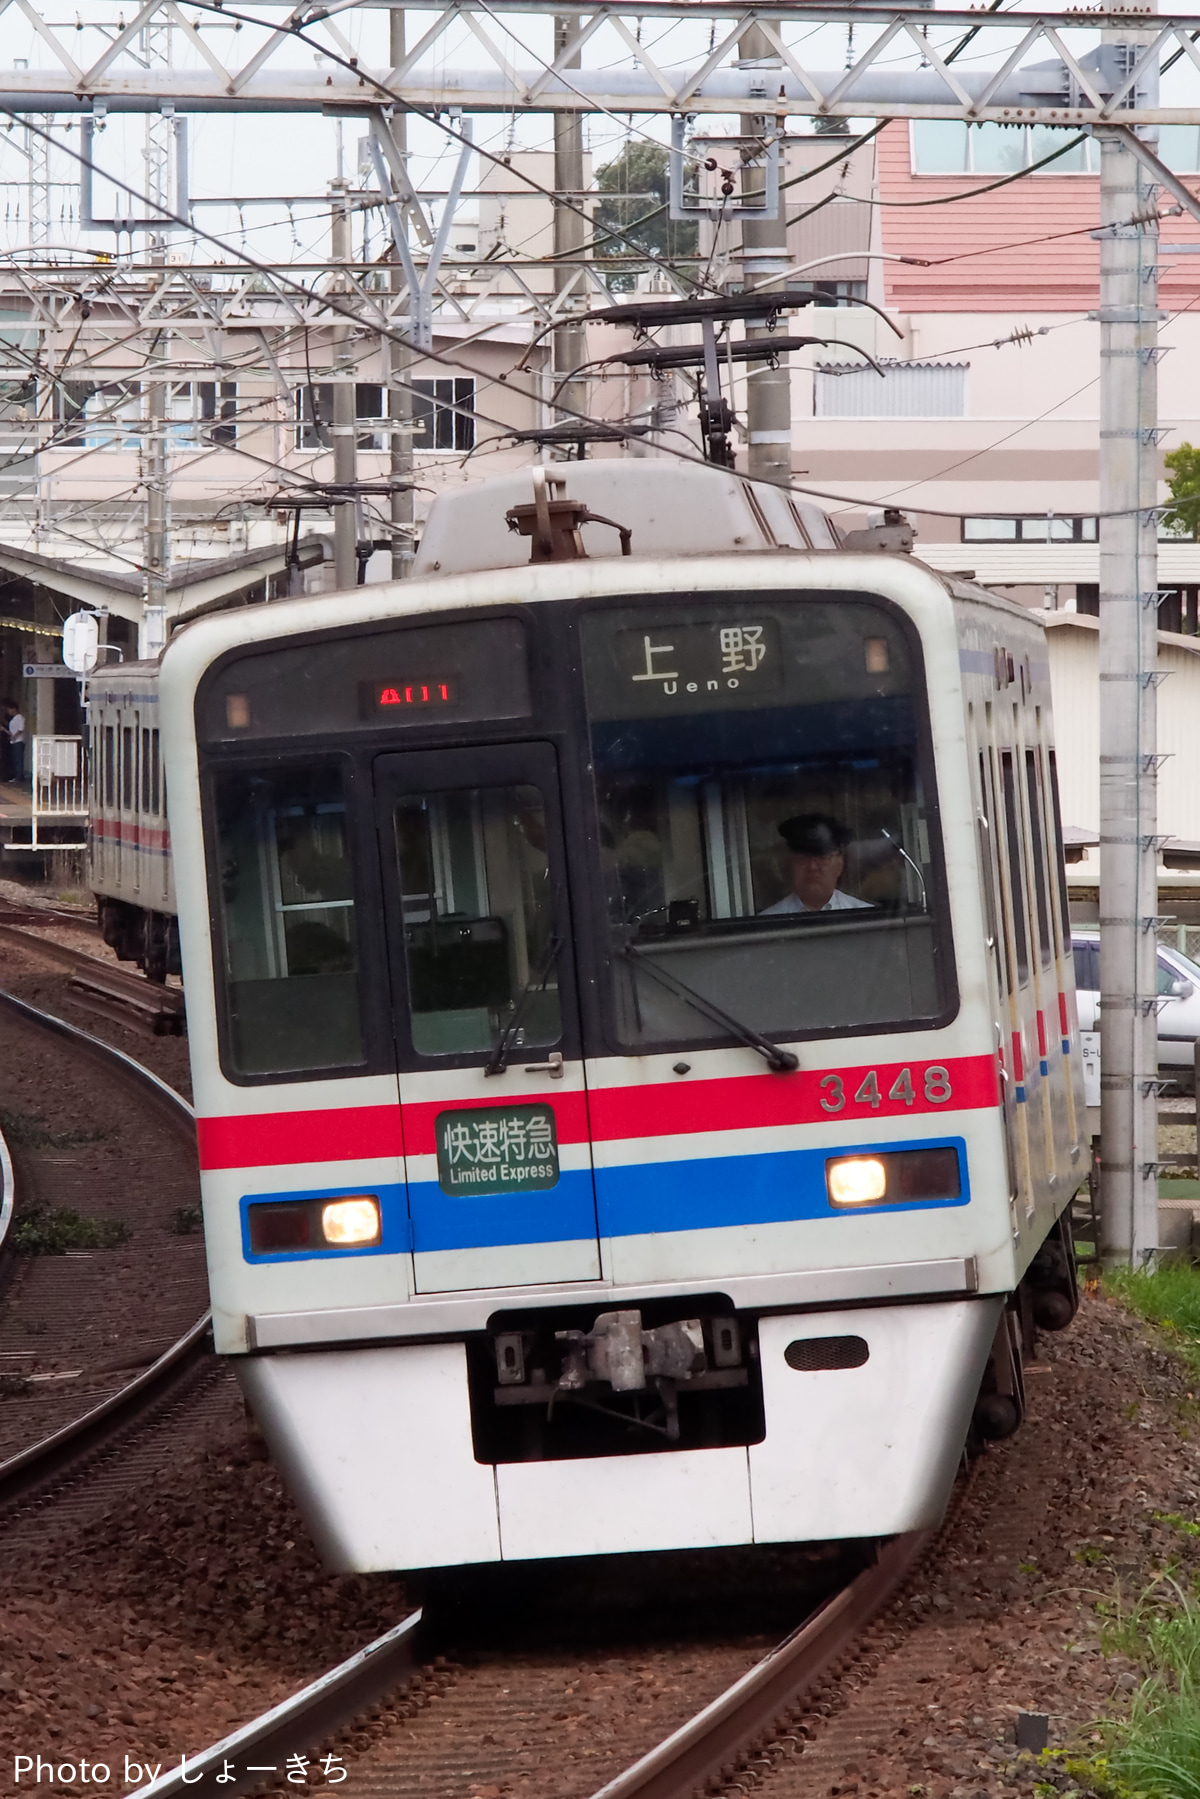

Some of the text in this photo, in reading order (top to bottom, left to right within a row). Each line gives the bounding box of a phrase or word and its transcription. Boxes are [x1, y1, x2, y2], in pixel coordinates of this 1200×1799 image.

[631, 625, 767, 682] 上野
[663, 678, 740, 695] Ueno
[819, 1065, 953, 1113] 3448
[443, 1115, 556, 1165] 快速特急
[450, 1163, 554, 1184] Limited Express
